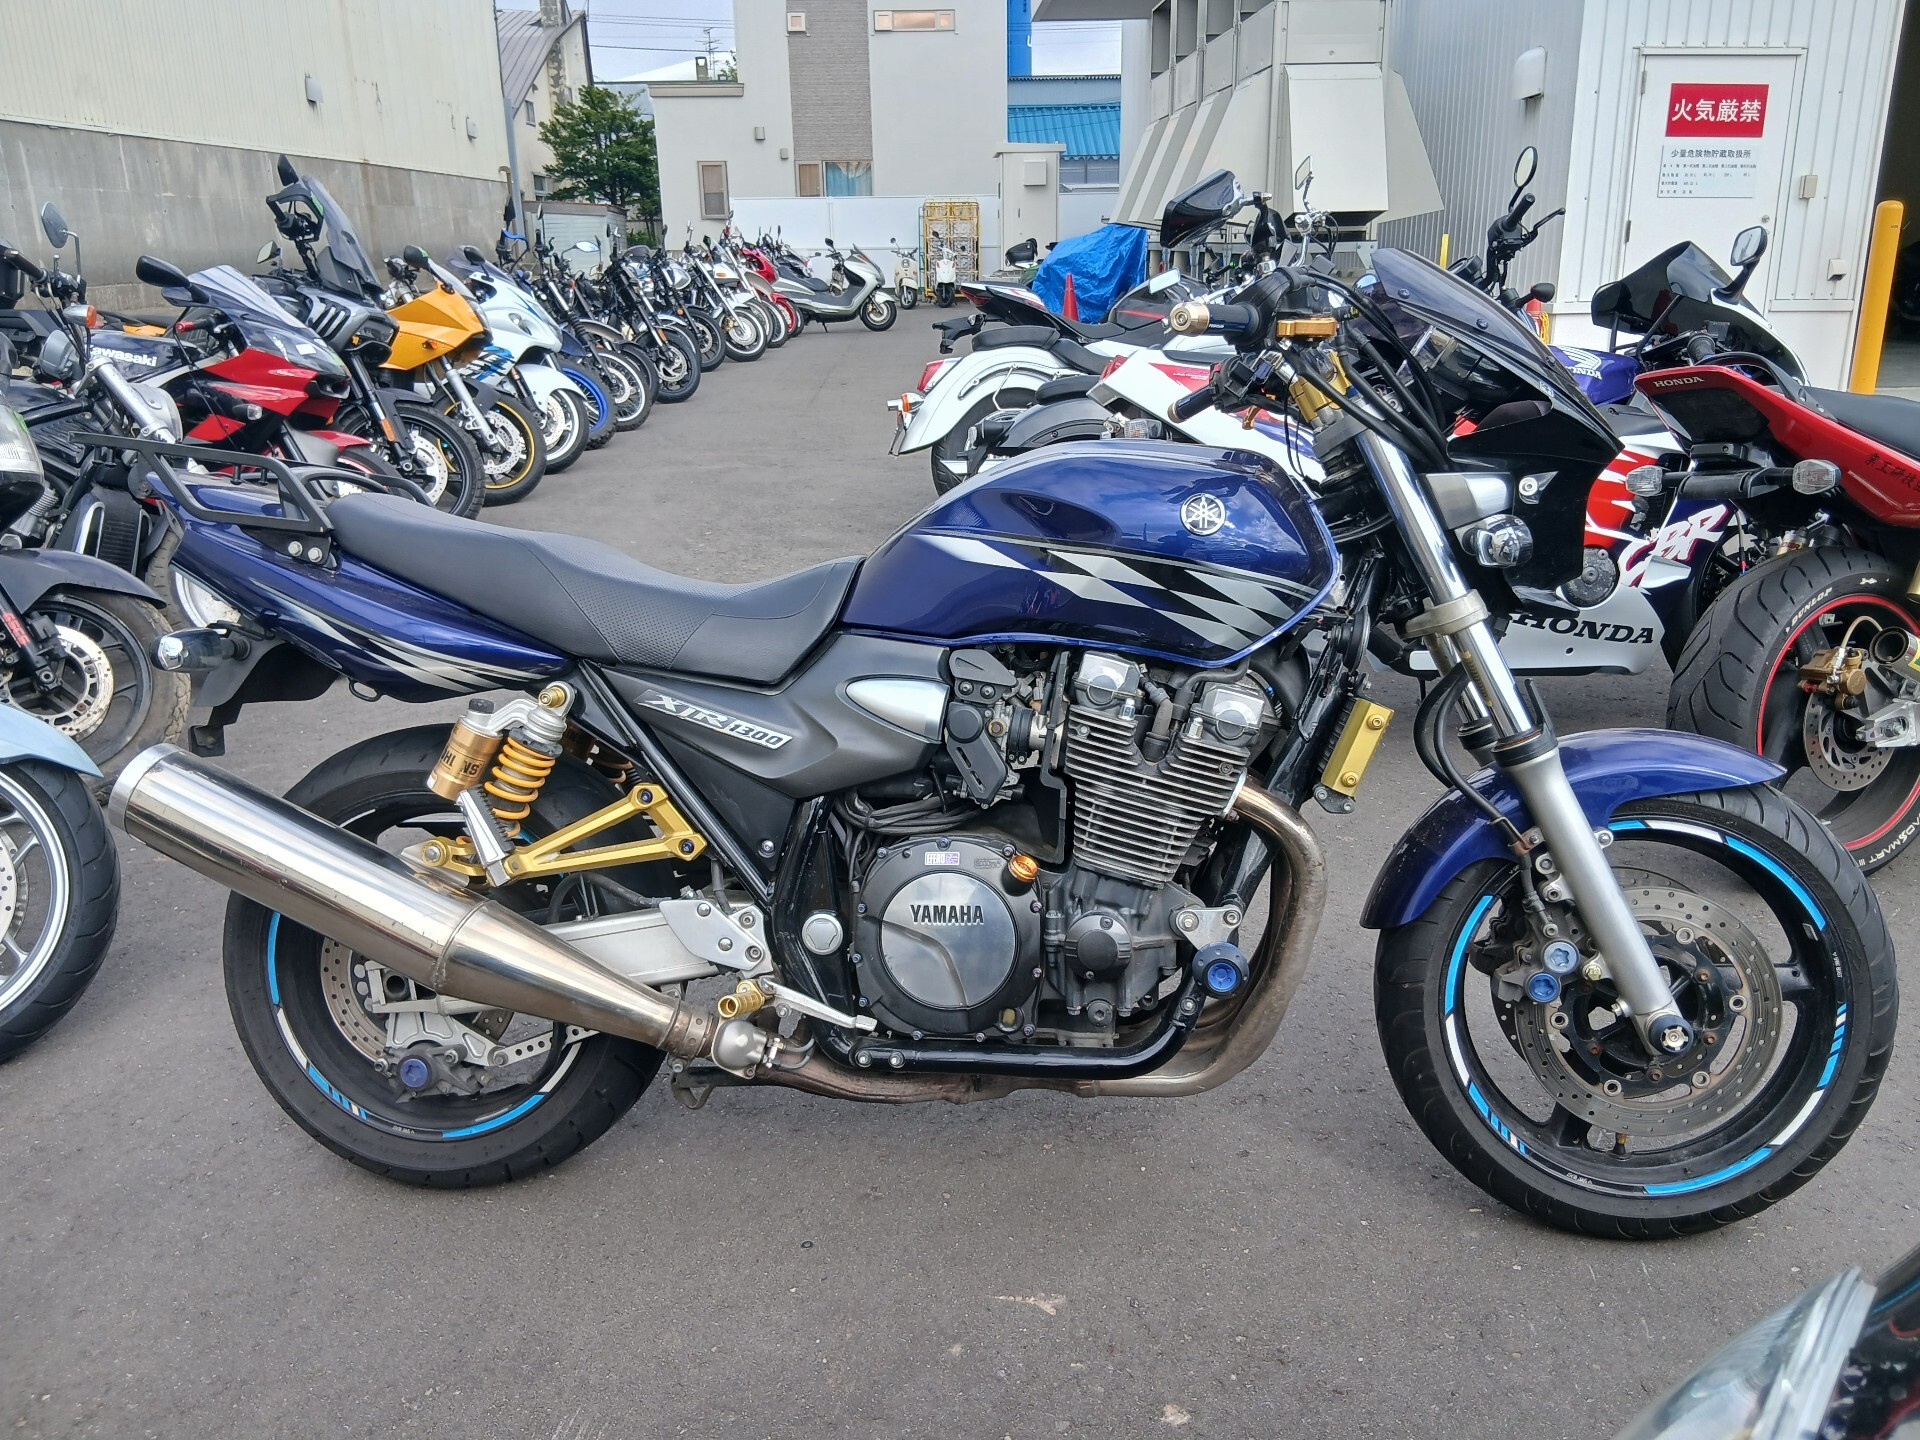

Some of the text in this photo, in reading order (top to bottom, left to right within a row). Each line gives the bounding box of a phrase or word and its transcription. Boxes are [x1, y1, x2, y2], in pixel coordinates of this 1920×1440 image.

[1671, 98, 1762, 122] 火気厳禁
[1670, 148, 1751, 159] 少量危険物貯蔵取扱所
[1652, 376, 1705, 388] HONDA
[1617, 503, 1729, 588] CBR
[1791, 586, 1833, 627] DUNLOP
[1511, 614, 1654, 644] HONDA
[644, 694, 785, 746] XJR 1300
[910, 904, 984, 924] YAMAHA
